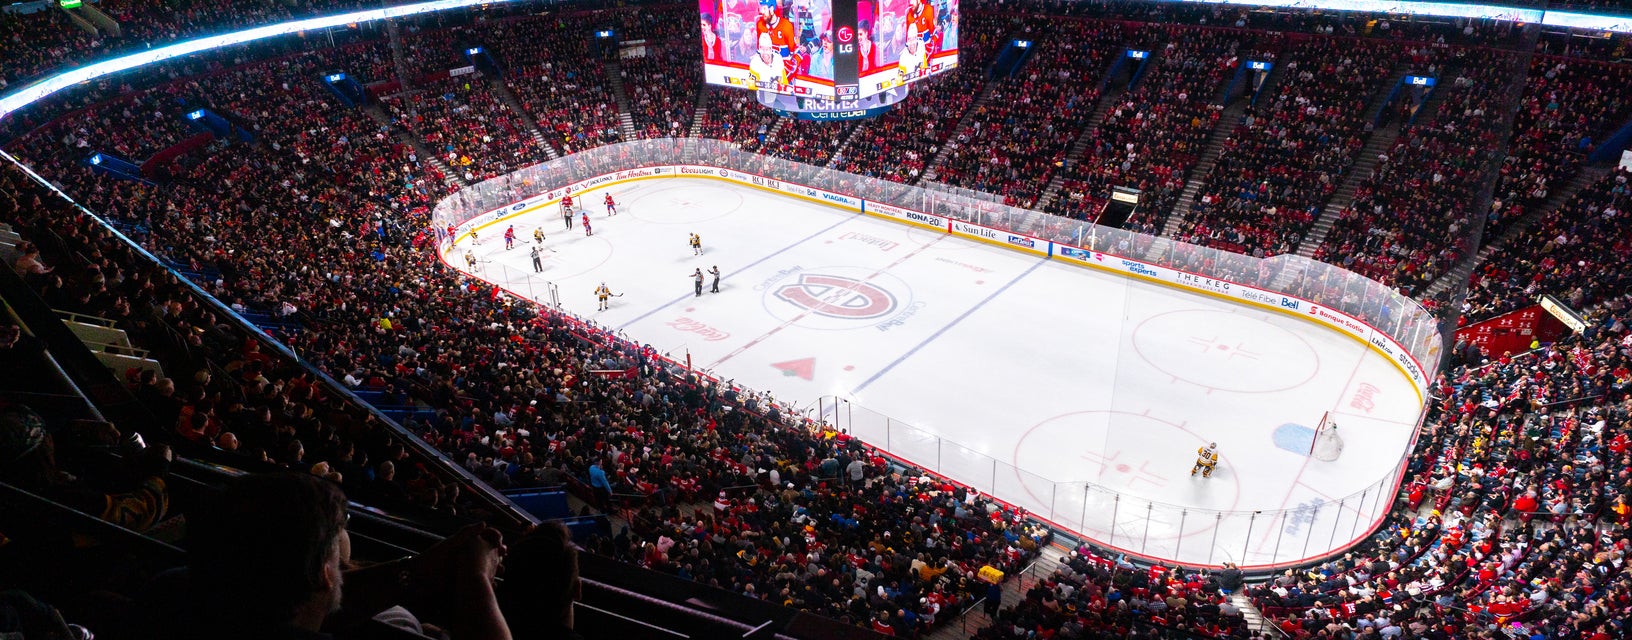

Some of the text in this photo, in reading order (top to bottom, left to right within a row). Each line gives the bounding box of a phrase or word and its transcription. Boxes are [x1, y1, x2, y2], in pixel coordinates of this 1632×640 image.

[839, 44, 853, 53] LG
[1413, 77, 1427, 85] Bell
[615, 172, 627, 180] Tim
[627, 170, 652, 179] Hortons
[807, 189, 816, 197] Bell
[497, 208, 508, 218] Bell
[906, 211, 929, 222] RONA
[929, 217, 939, 226] 20
[963, 224, 996, 239] Sun Life
[1122, 259, 1144, 269] sports
[1129, 266, 1157, 277] experts
[1177, 272, 1230, 290] THE KEG
[1241, 289, 1299, 309] Télé Fibe Bell
[1320, 310, 1344, 324] Banque
[1345, 320, 1364, 334] Scotia
[1202, 450, 1211, 460] 30
[1348, 604, 1356, 614] 15
